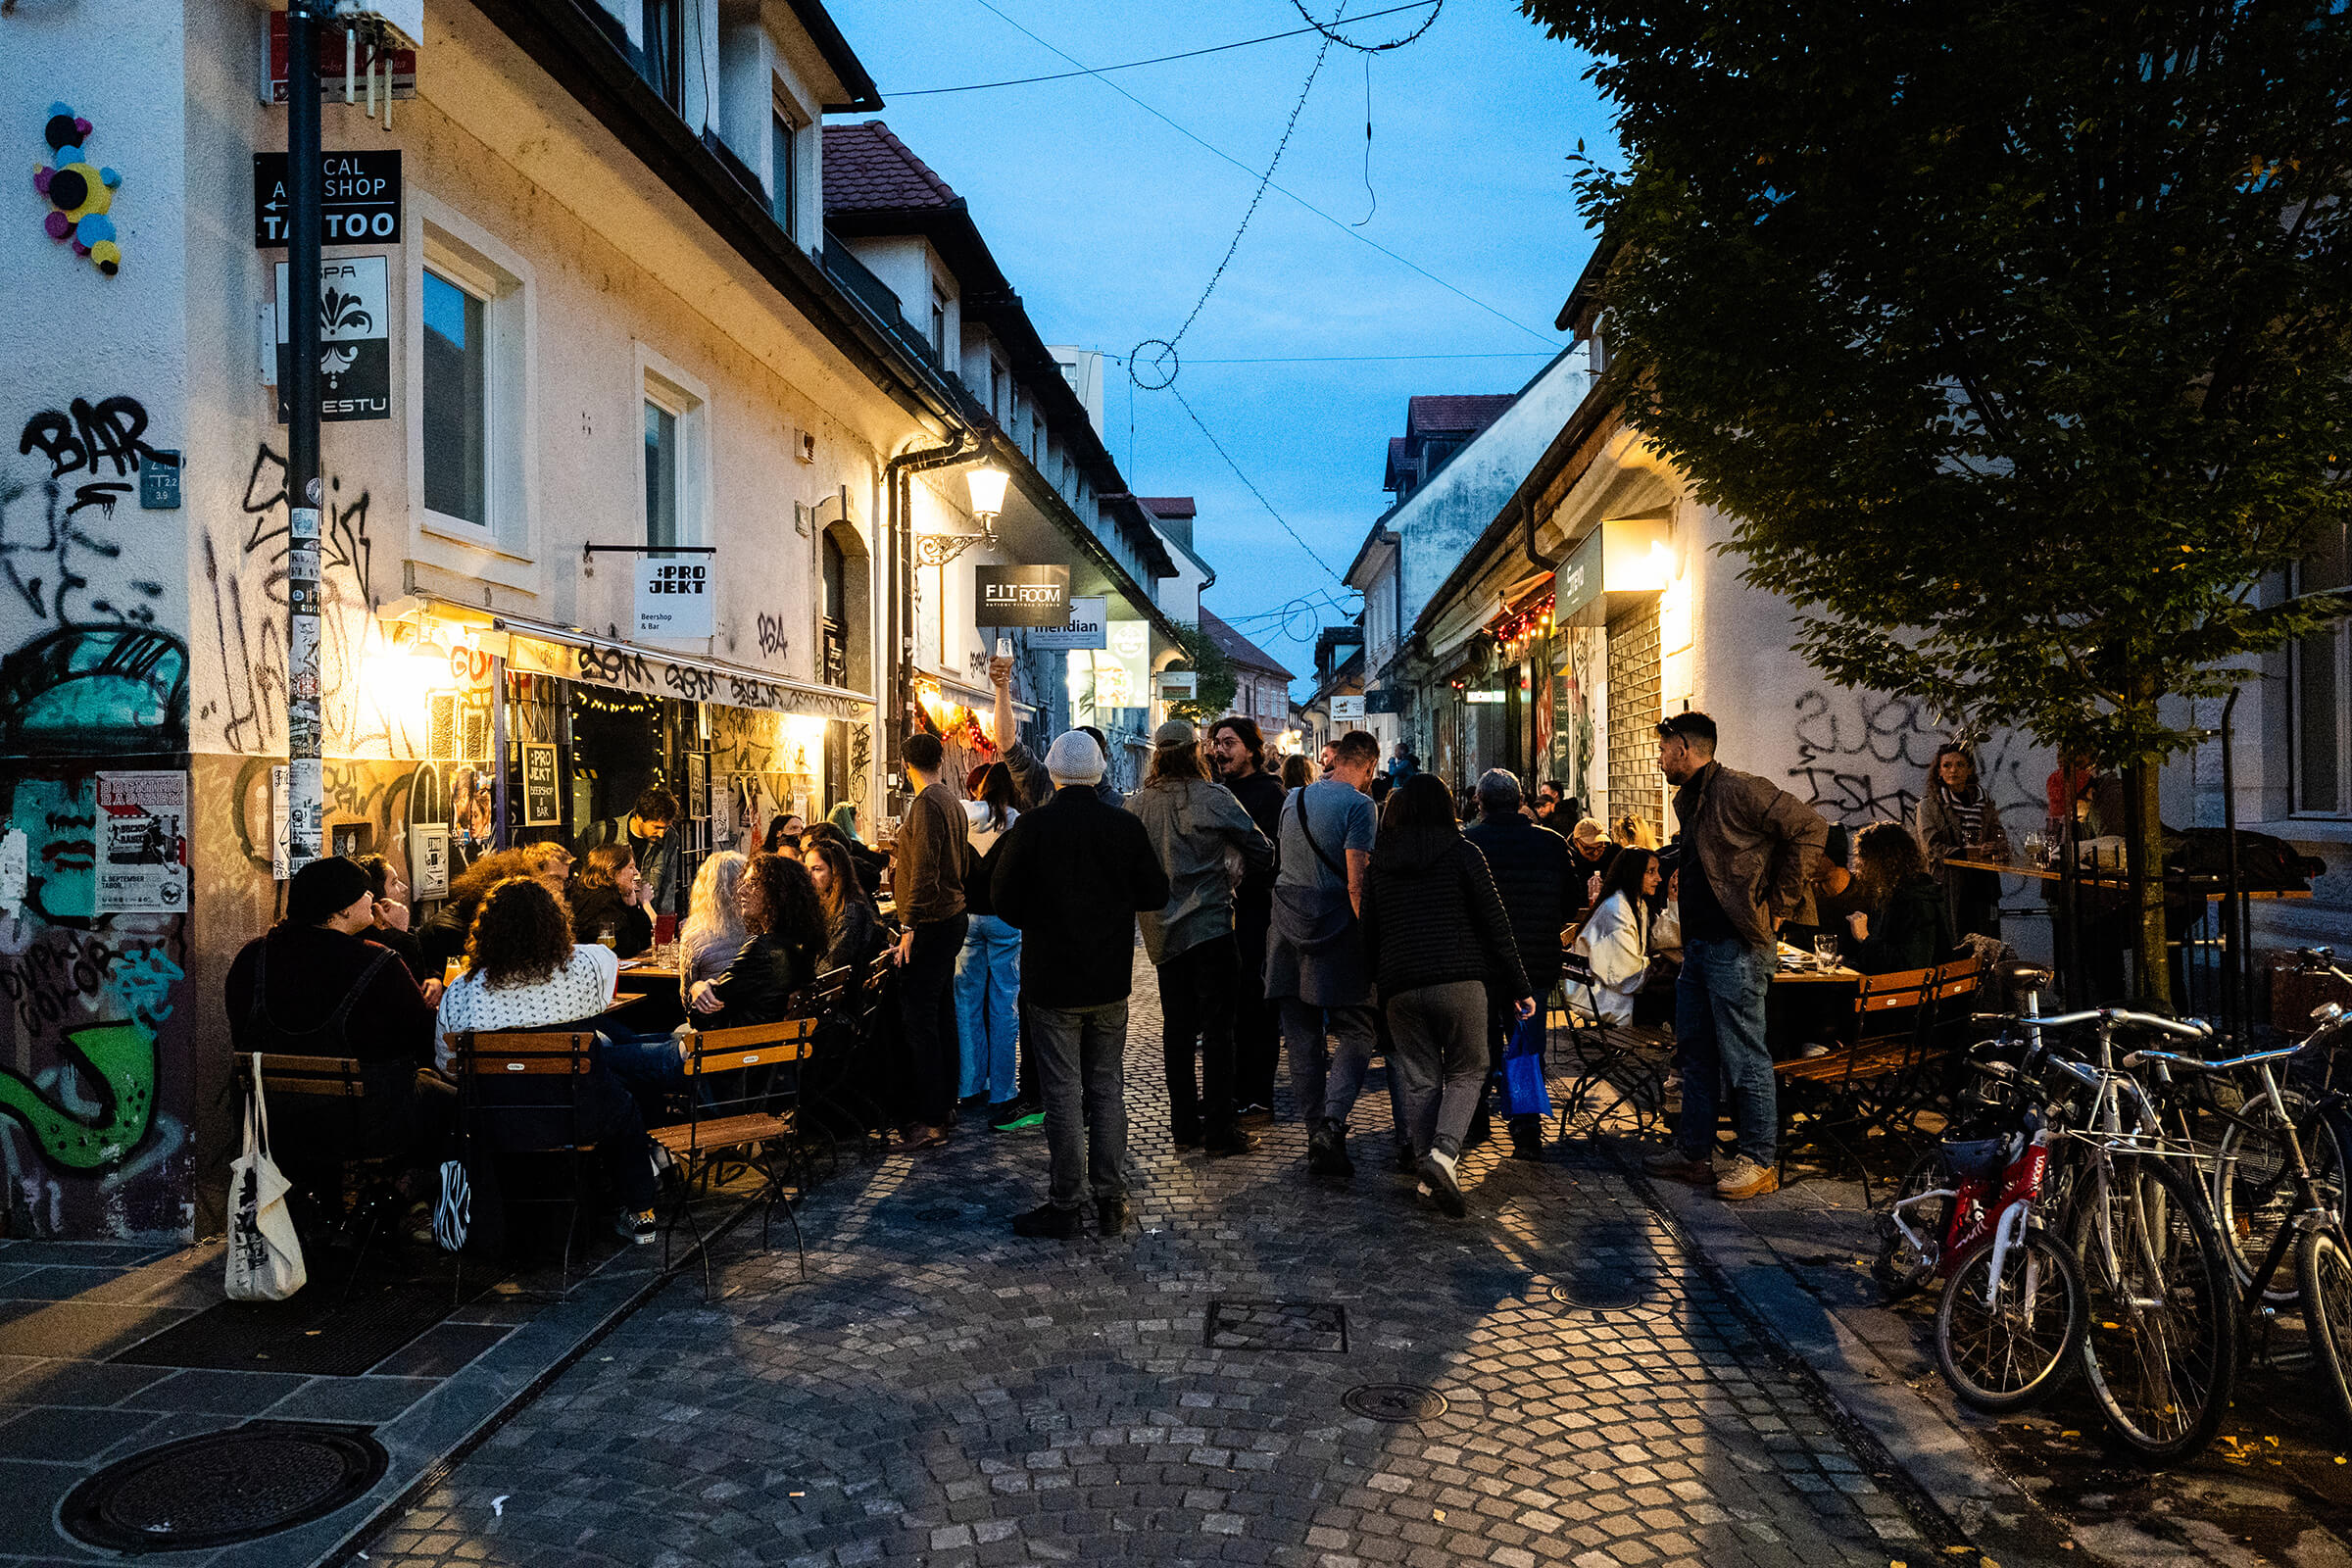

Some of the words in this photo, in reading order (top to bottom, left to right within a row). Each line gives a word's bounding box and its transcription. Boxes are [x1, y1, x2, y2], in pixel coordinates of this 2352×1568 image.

[324, 178, 386, 197] SHOP
[264, 213, 394, 240] TTOO
[649, 580, 706, 594] JEKT
[530, 750, 552, 766] :PRO
[529, 767, 552, 782] JEKT
[529, 785, 554, 796] BEERSHOP
[100, 793, 184, 806] RASIZEM
[536, 807, 550, 817] BAR
